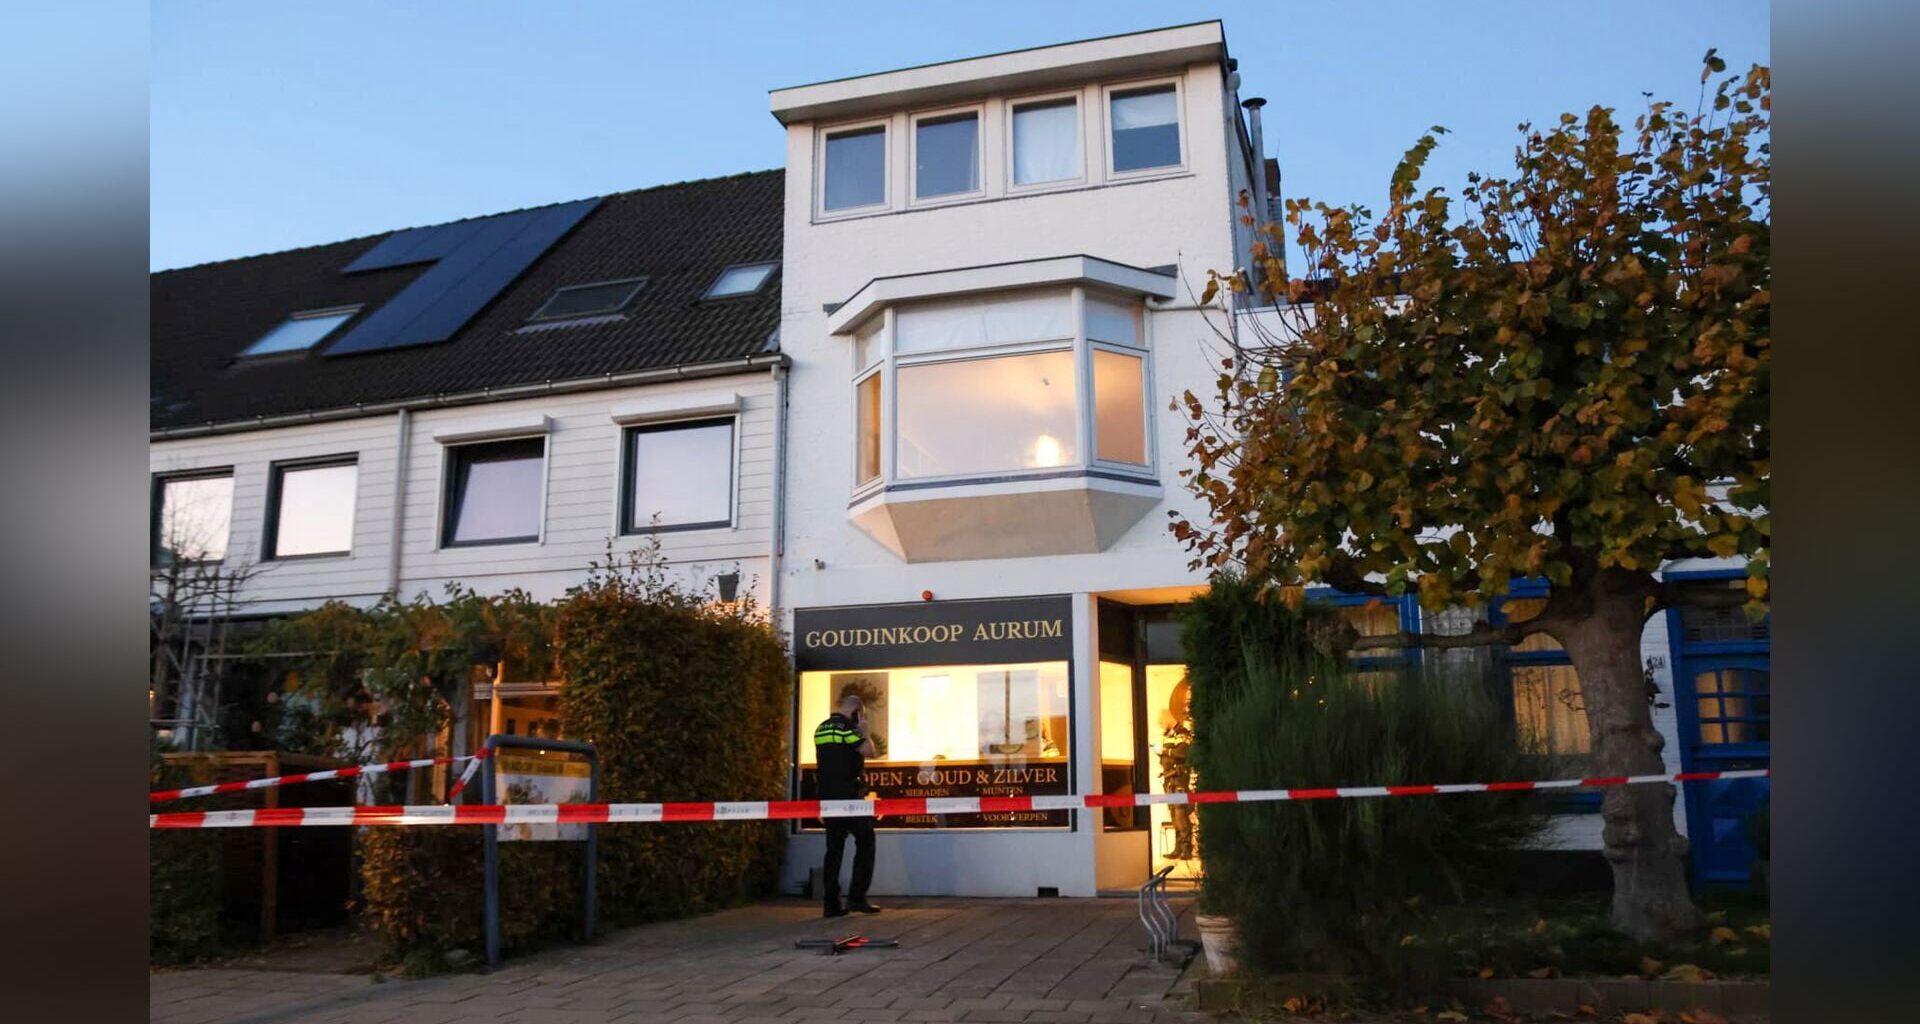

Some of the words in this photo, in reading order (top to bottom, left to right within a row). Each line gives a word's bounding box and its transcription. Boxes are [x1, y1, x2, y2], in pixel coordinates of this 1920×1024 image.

[805, 624, 963, 648] GOUDINKOOP
[973, 619, 1063, 641] AURUM
[916, 770, 972, 785] GOUD
[976, 770, 989, 784] &
[993, 768, 1057, 784] ZILVER
